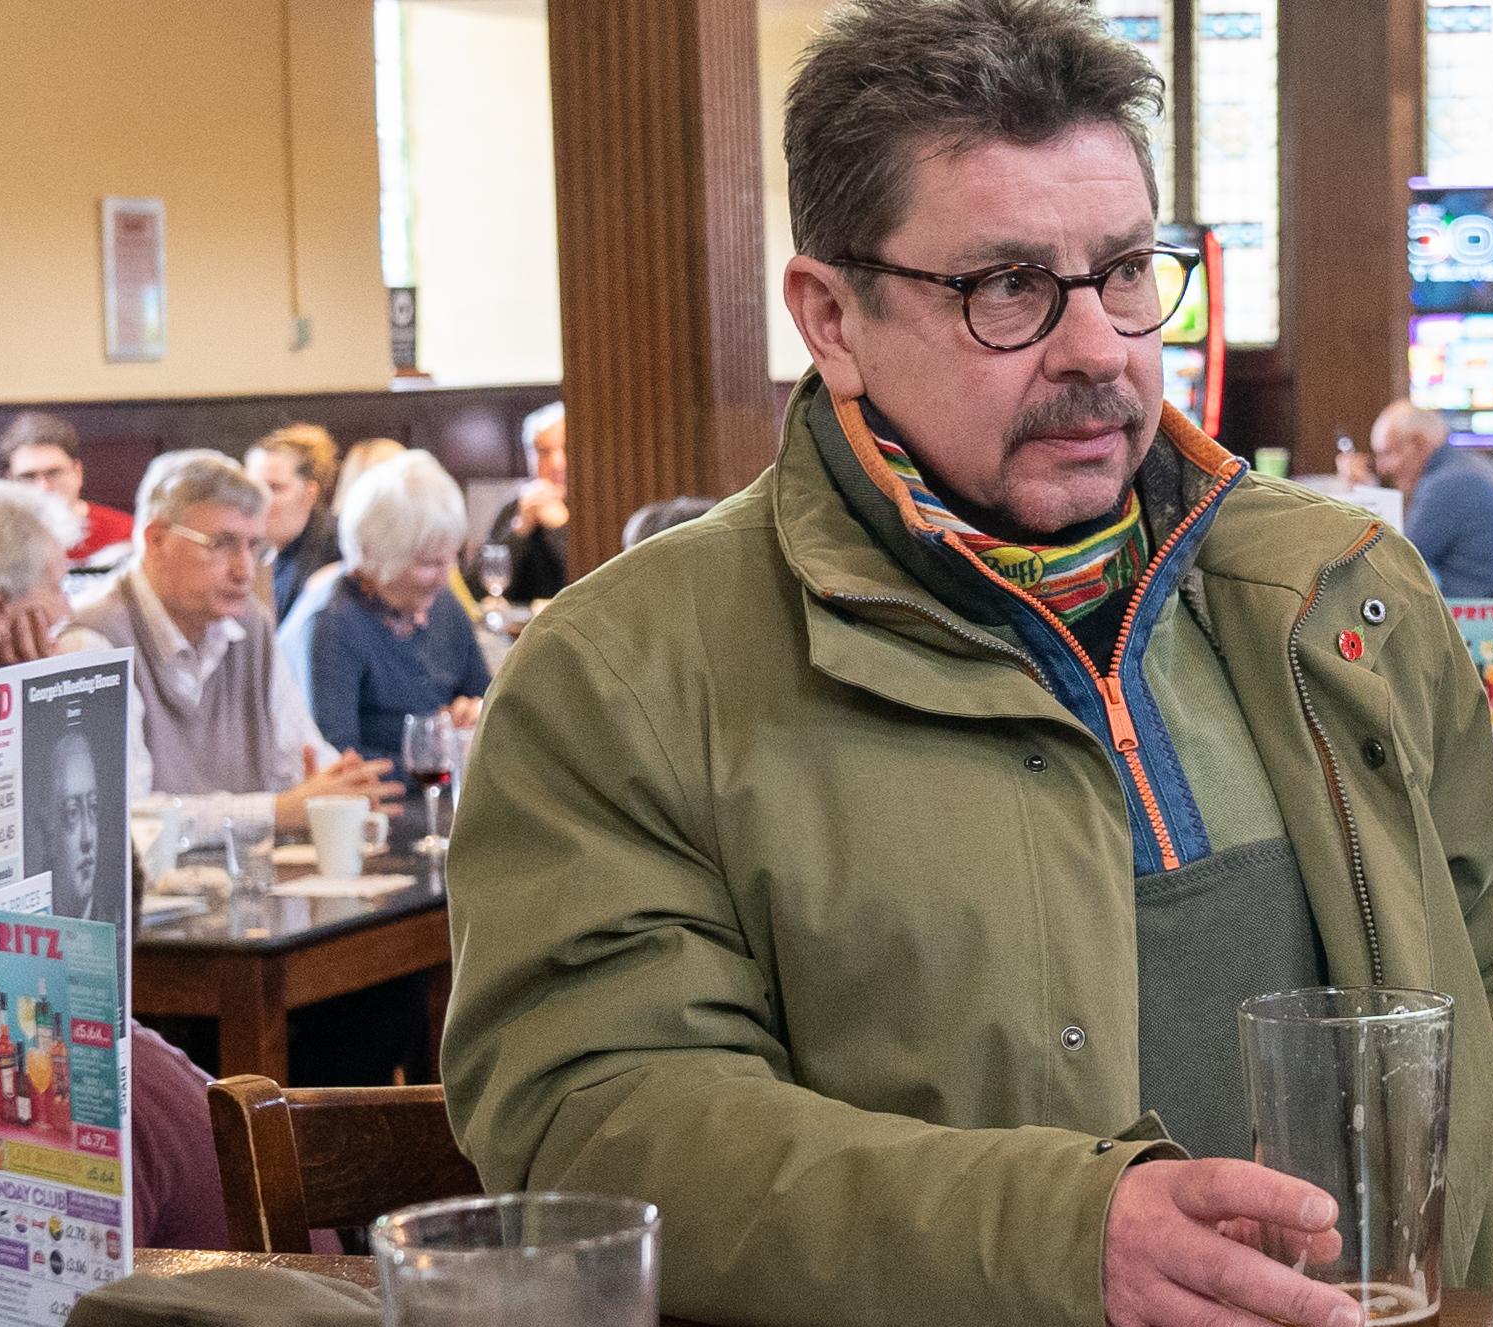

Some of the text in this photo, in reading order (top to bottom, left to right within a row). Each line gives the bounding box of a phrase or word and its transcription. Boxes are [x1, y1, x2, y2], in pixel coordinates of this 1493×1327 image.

[63, 676, 95, 695] Meeting
[94, 673, 121, 690] House
[32, 1188, 66, 1210] CLUB
